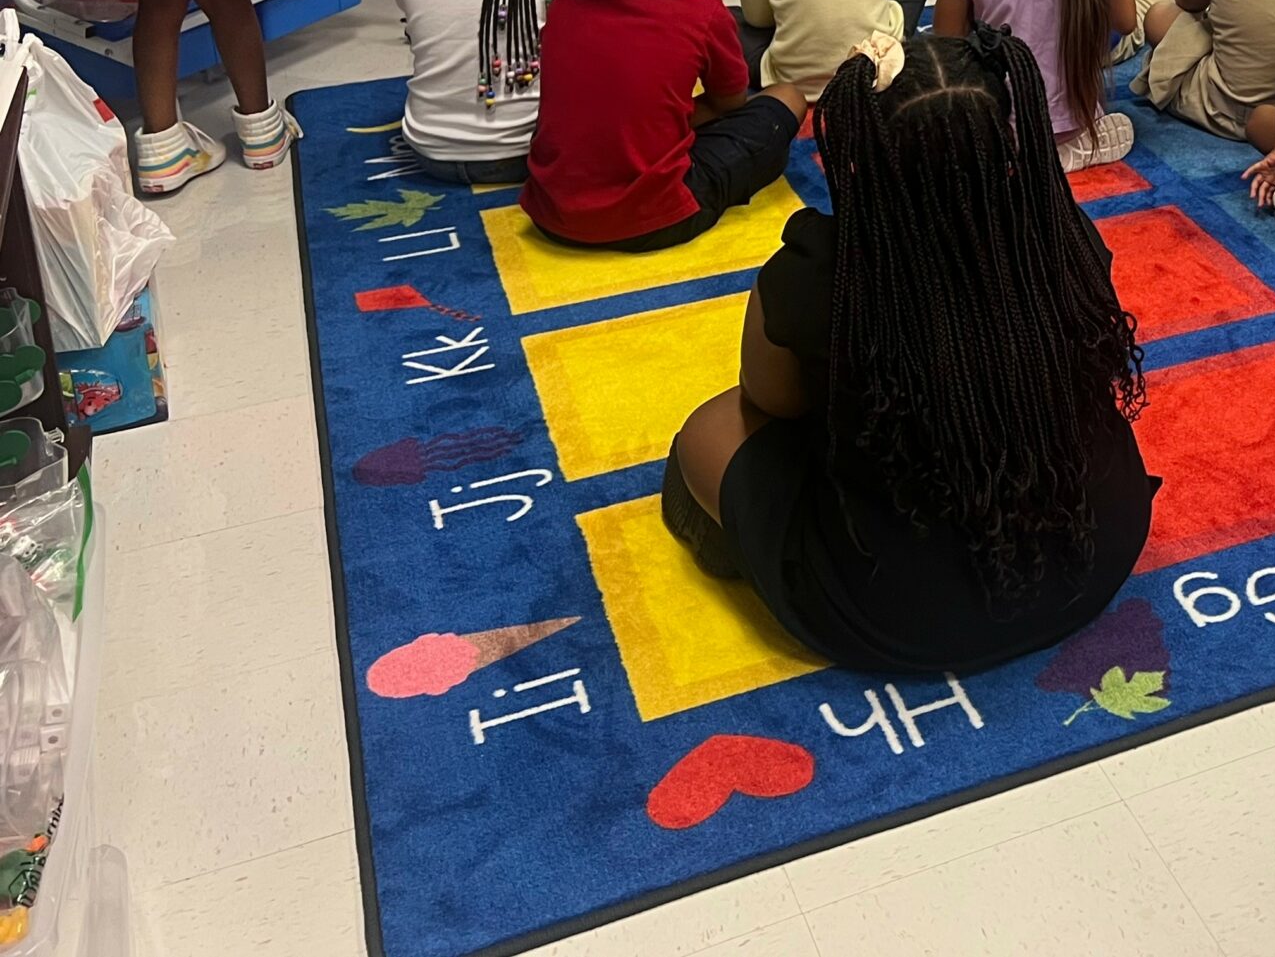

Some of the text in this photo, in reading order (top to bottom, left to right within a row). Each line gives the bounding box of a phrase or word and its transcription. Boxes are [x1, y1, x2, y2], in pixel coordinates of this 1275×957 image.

[377, 226, 461, 262] Ll
[402, 326, 496, 386] Kk
[429, 467, 553, 530] Jj
[468, 667, 591, 746] Ii
[818, 671, 985, 755] Hh
